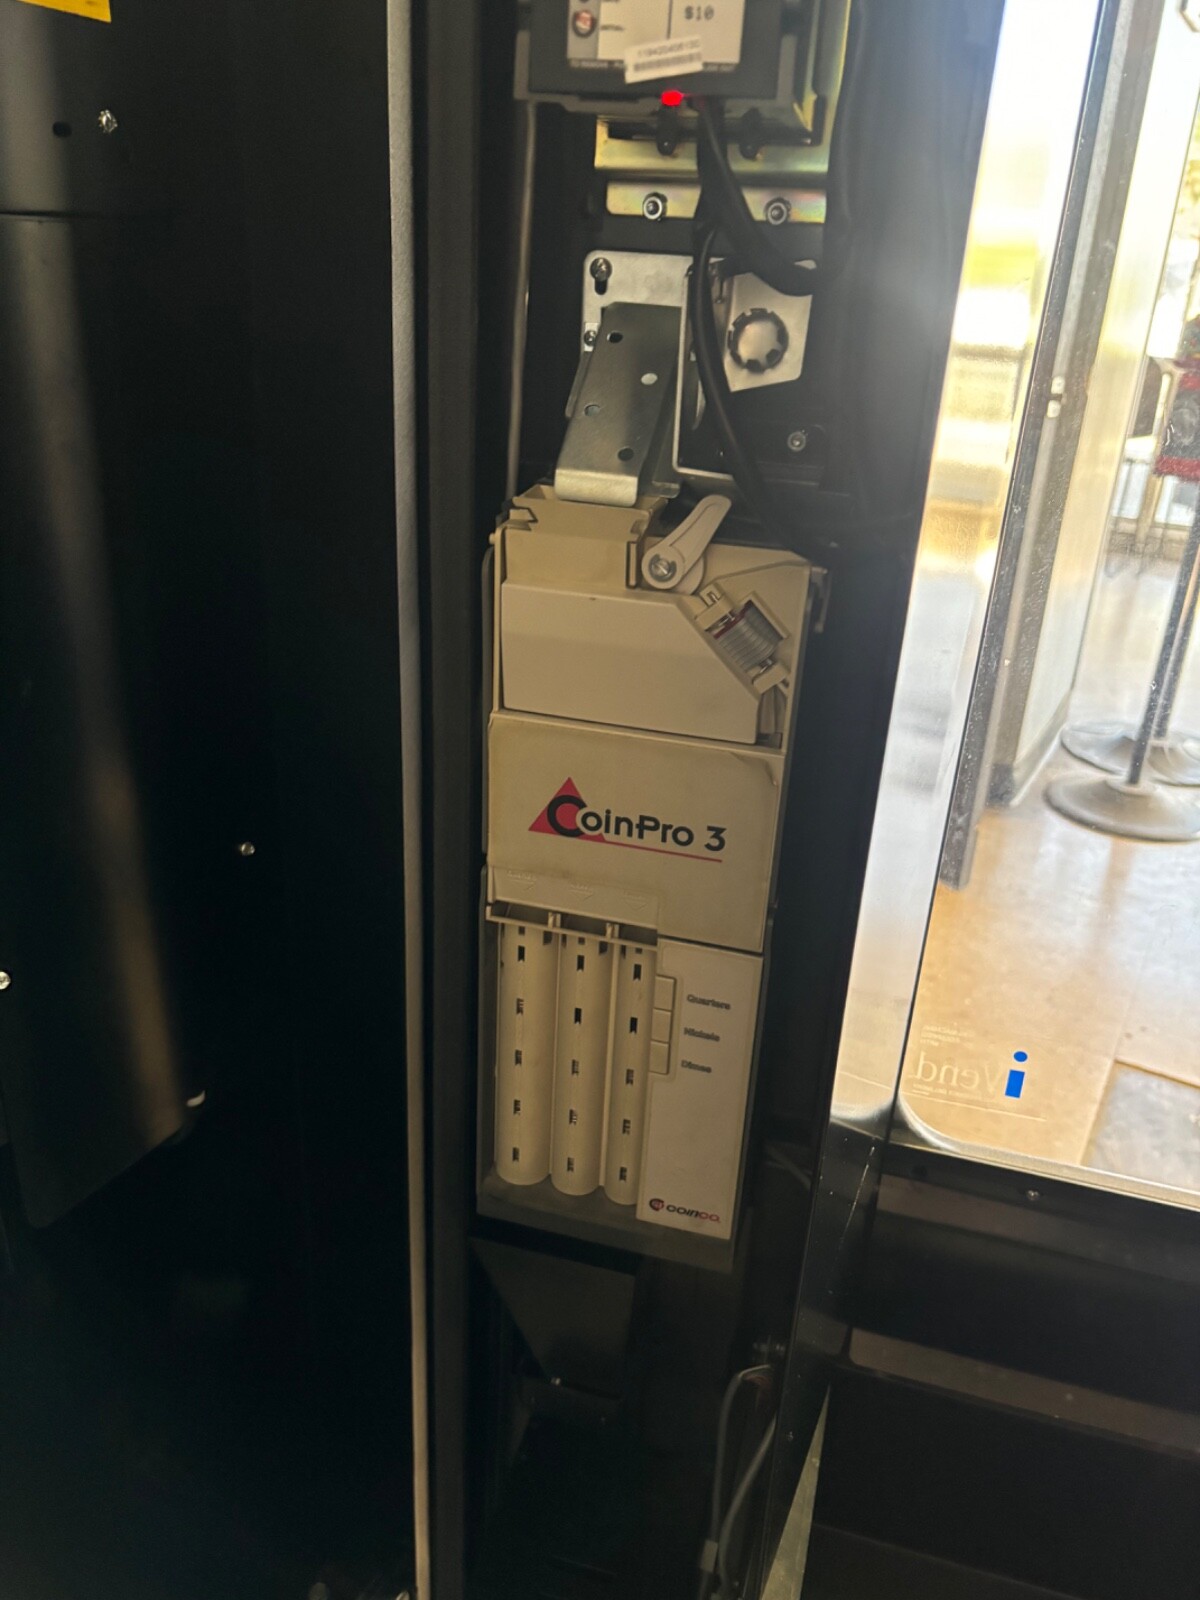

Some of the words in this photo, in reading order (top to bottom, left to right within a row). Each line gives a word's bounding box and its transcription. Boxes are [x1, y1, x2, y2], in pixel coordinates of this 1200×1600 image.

[684, 5, 715, 21] $10
[546, 794, 695, 847] CoinPro
[704, 825, 728, 852] 3
